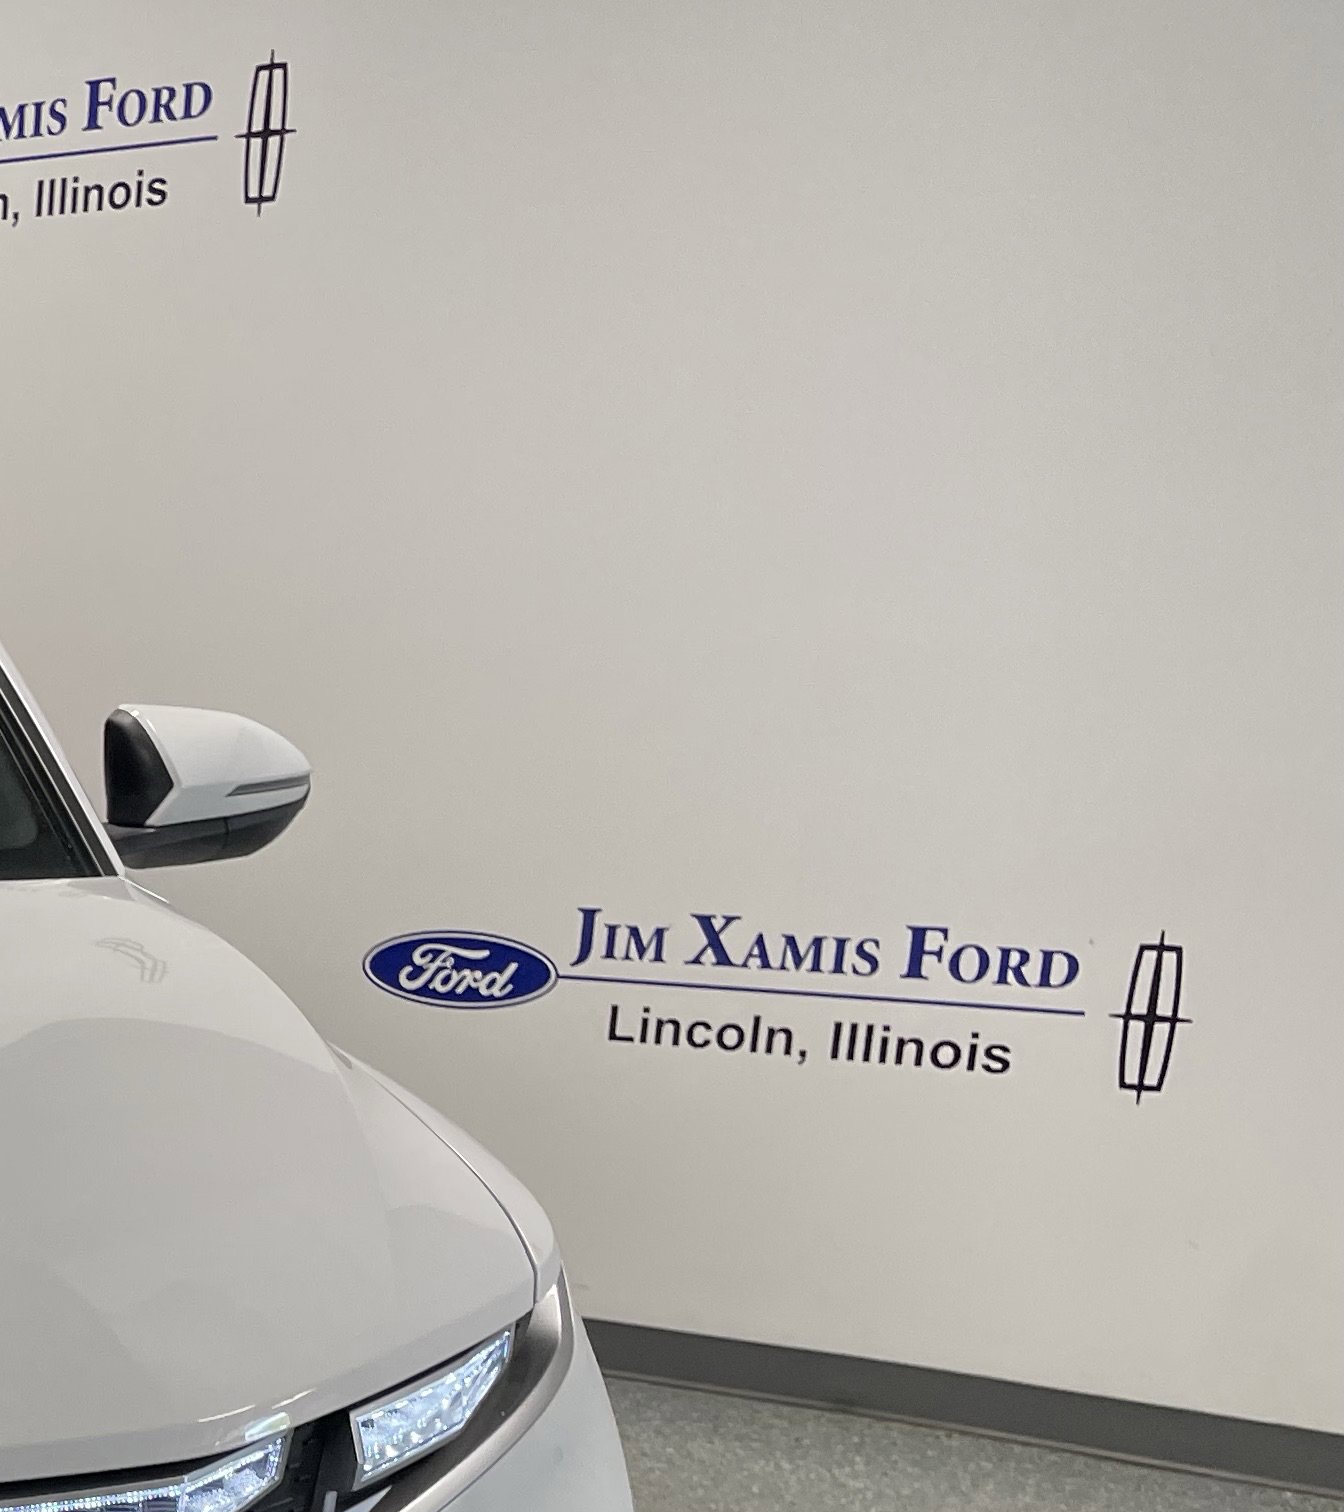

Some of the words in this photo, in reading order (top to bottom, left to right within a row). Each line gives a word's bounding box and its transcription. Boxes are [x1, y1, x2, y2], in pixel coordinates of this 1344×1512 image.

[35, 169, 169, 217] Illinois
[398, 945, 515, 1000] Ford
[607, 1004, 809, 1066] Lincoln,
[829, 1021, 1014, 1076] Illinois
